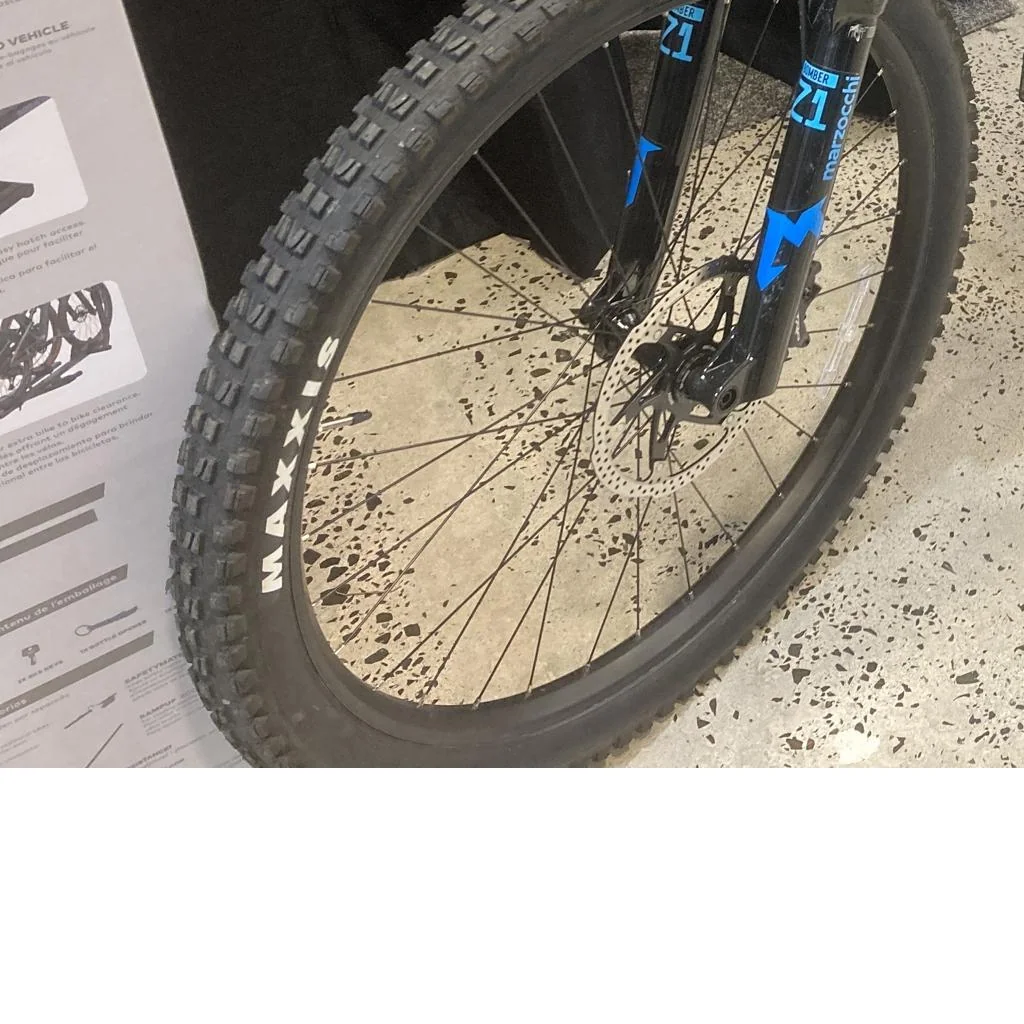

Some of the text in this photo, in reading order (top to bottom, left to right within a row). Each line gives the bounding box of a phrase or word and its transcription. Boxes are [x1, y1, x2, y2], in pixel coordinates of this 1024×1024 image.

[8, 20, 70, 47] VEHICLE
[822, 73, 860, 181] marzocchi
[261, 335, 340, 594] MAXXIS
[34, 605, 49, 617] de
